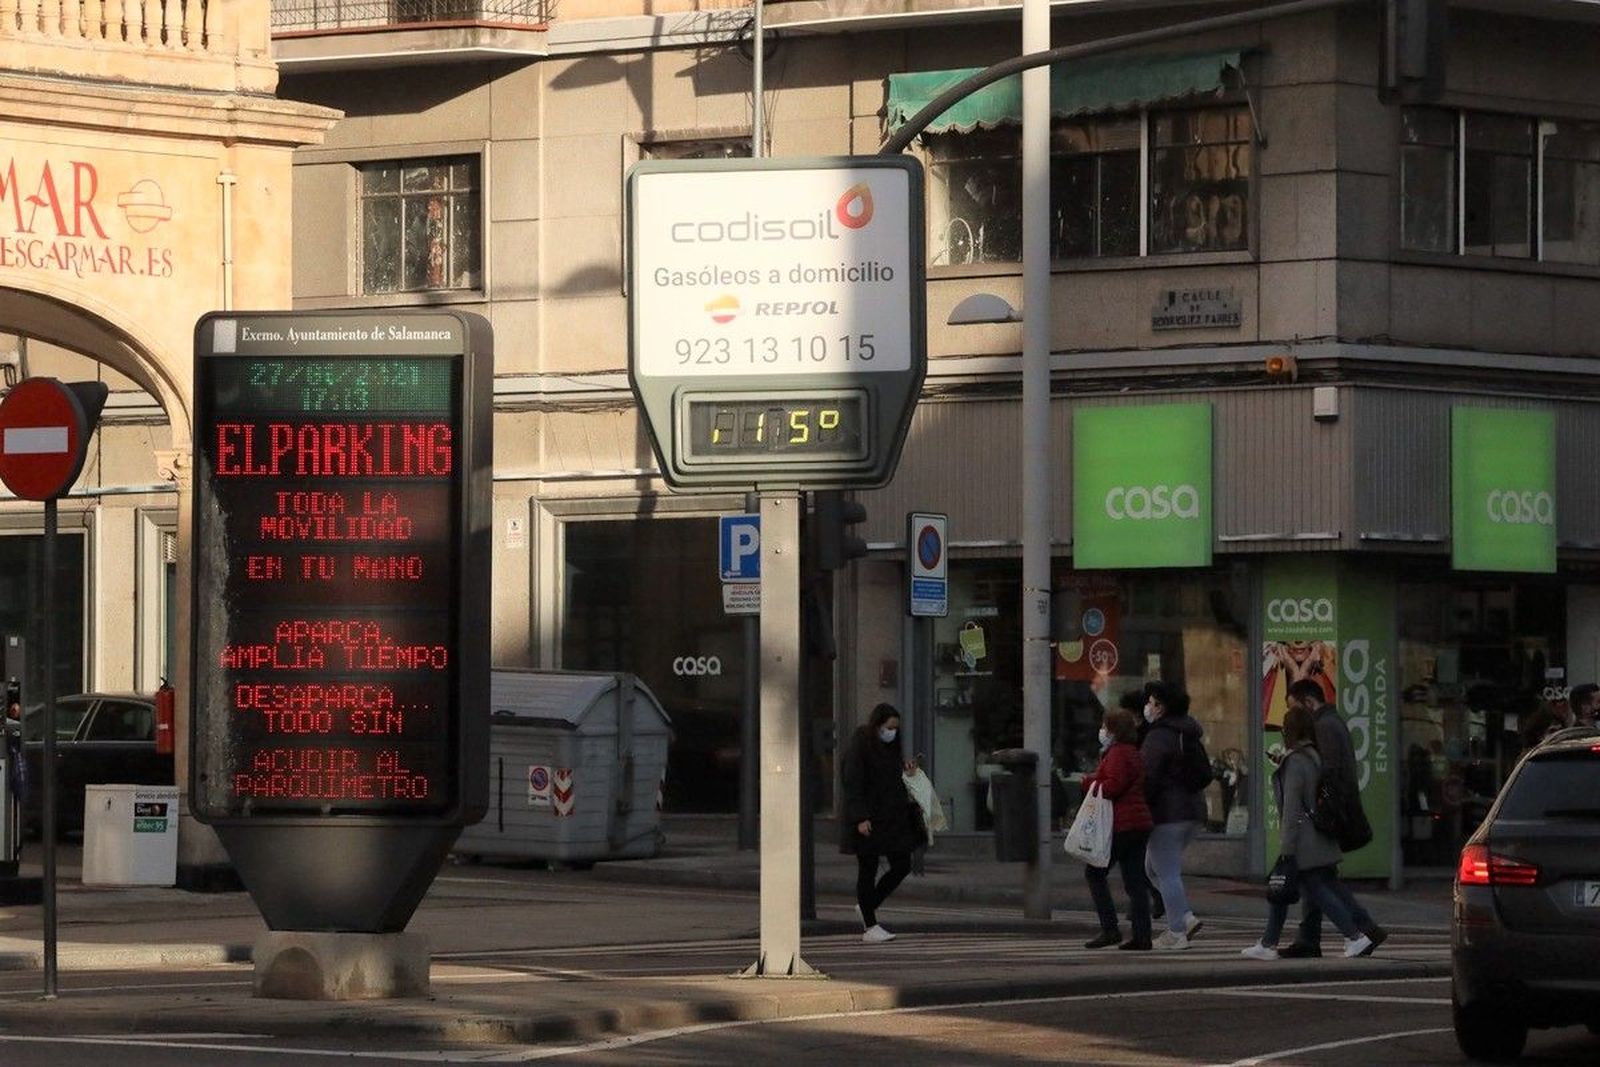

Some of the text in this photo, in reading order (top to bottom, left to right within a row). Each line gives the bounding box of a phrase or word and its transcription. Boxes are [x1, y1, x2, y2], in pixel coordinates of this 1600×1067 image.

[671, 211, 840, 243] codisoil
[654, 261, 894, 287] Gasóleos a domicilio
[755, 301, 839, 316] REPSOL
[287, 326, 368, 347] Ayuntamiento
[371, 327, 385, 341] de
[388, 325, 451, 341] Salamanca
[675, 334, 875, 365] 923 13 10 15
[215, 423, 452, 476] ELPARKING
[276, 491, 398, 514] TODA LA
[1105, 484, 1200, 520] casa
[1486, 488, 1554, 525] casa
[260, 516, 412, 540] MOVILIDAD
[730, 524, 760, 571] P
[247, 556, 424, 580] EN TU MANO
[1267, 598, 1334, 624] casa
[219, 645, 448, 669] AMPLIA TIEMPO
[673, 656, 721, 676] casa
[263, 710, 403, 733] TODO SIN
[1375, 658, 1387, 773] ENTRADA
[253, 749, 410, 773] ACUDIR AL
